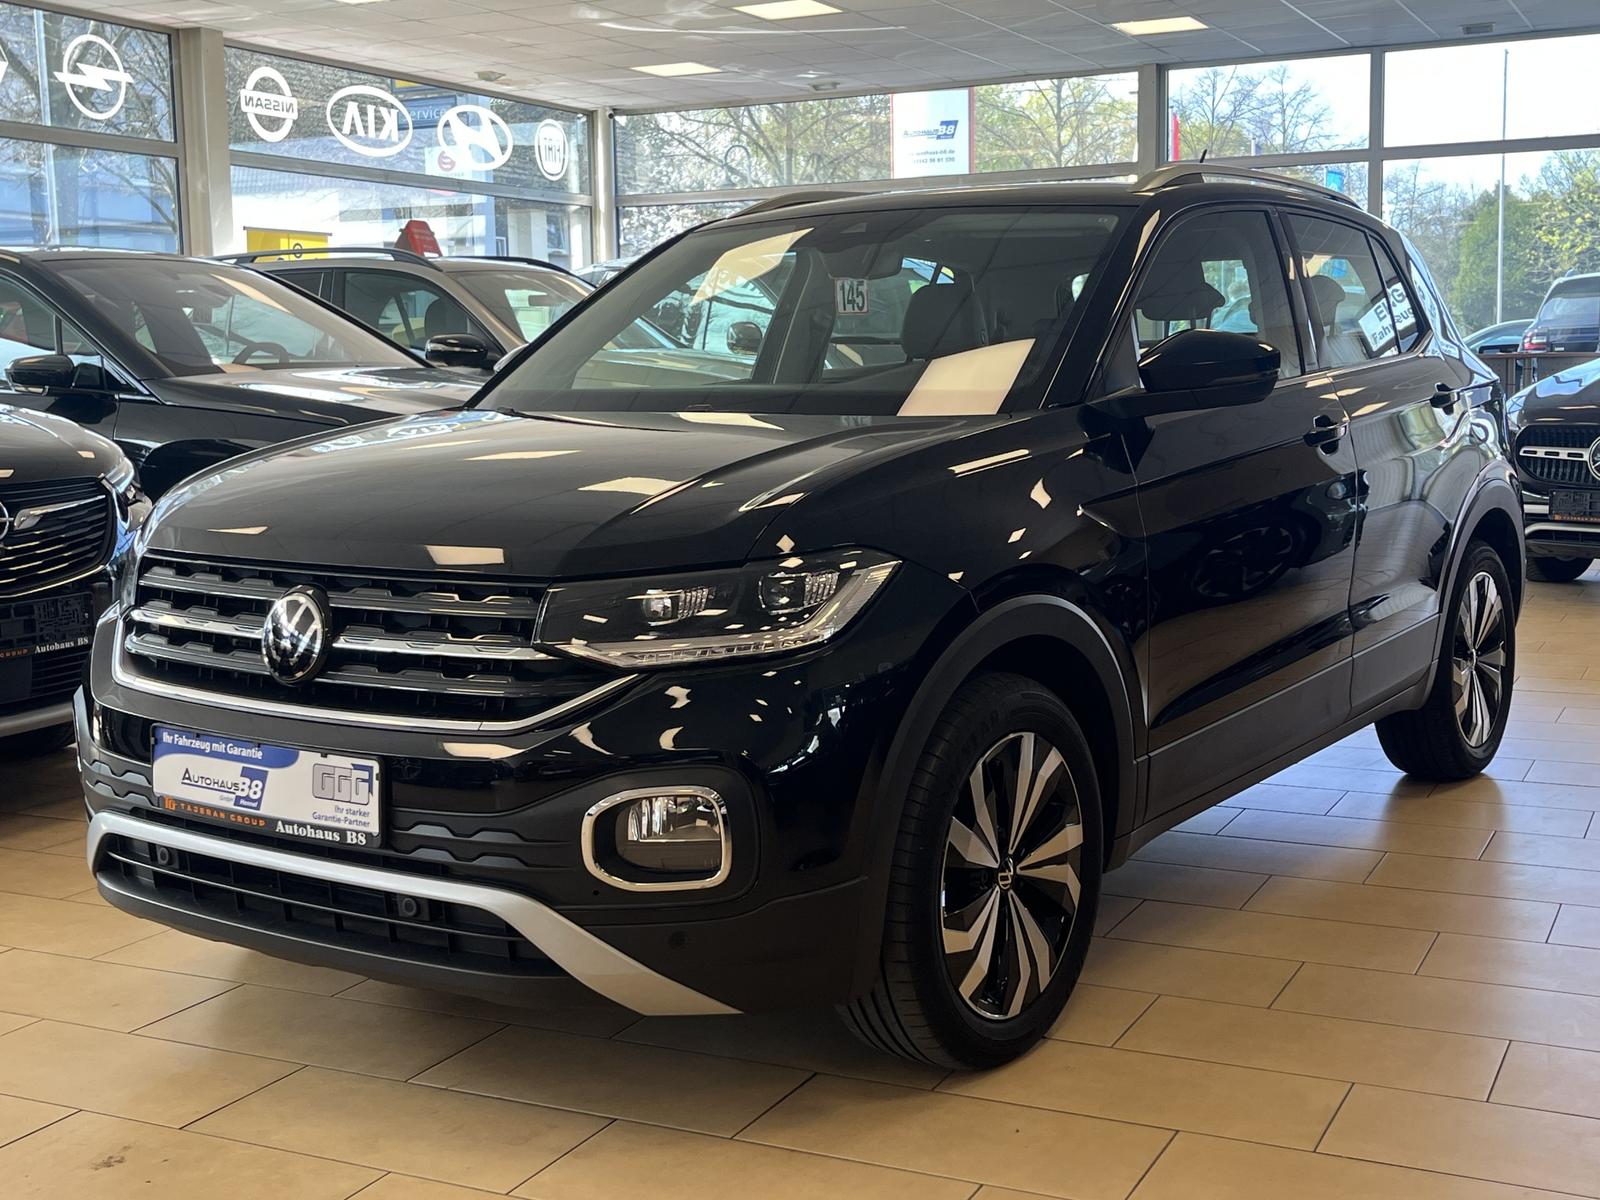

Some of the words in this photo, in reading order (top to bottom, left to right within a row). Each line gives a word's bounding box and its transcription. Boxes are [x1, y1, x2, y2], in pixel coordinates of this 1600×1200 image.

[839, 280, 865, 312] 145
[34, 640, 75, 654] Autohaus
[163, 732, 173, 743] Ihr
[174, 734, 210, 753] Fahrzeug
[212, 742, 225, 753] mit
[226, 743, 263, 759] Garantie
[312, 811, 370, 828] Garantie-Partner
[345, 809, 370, 818] starker
[275, 820, 341, 843] Autohaus
[346, 830, 367, 846] B8
